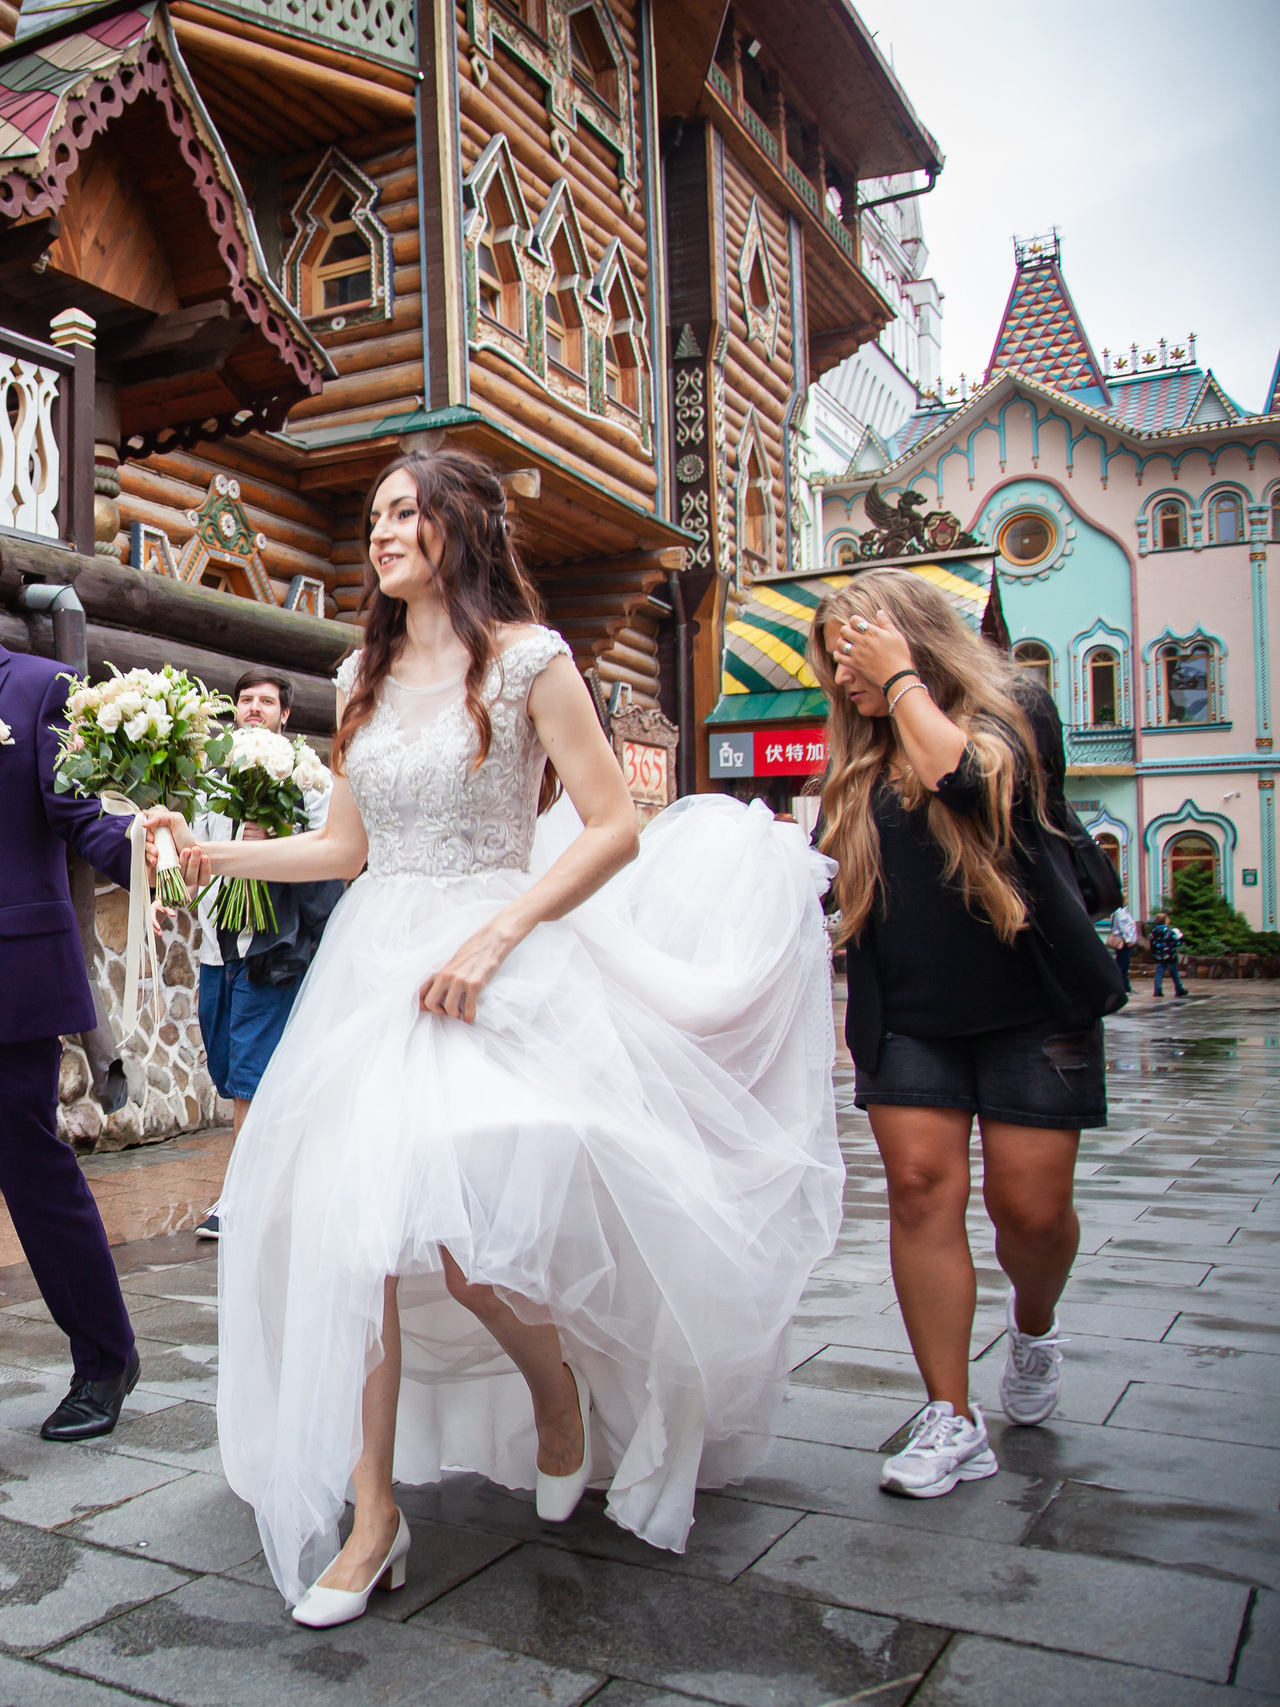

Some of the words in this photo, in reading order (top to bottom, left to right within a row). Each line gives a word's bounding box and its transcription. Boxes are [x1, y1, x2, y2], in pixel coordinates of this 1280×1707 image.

[625, 743, 662, 790] 365
[765, 742, 830, 763] 伏特加
